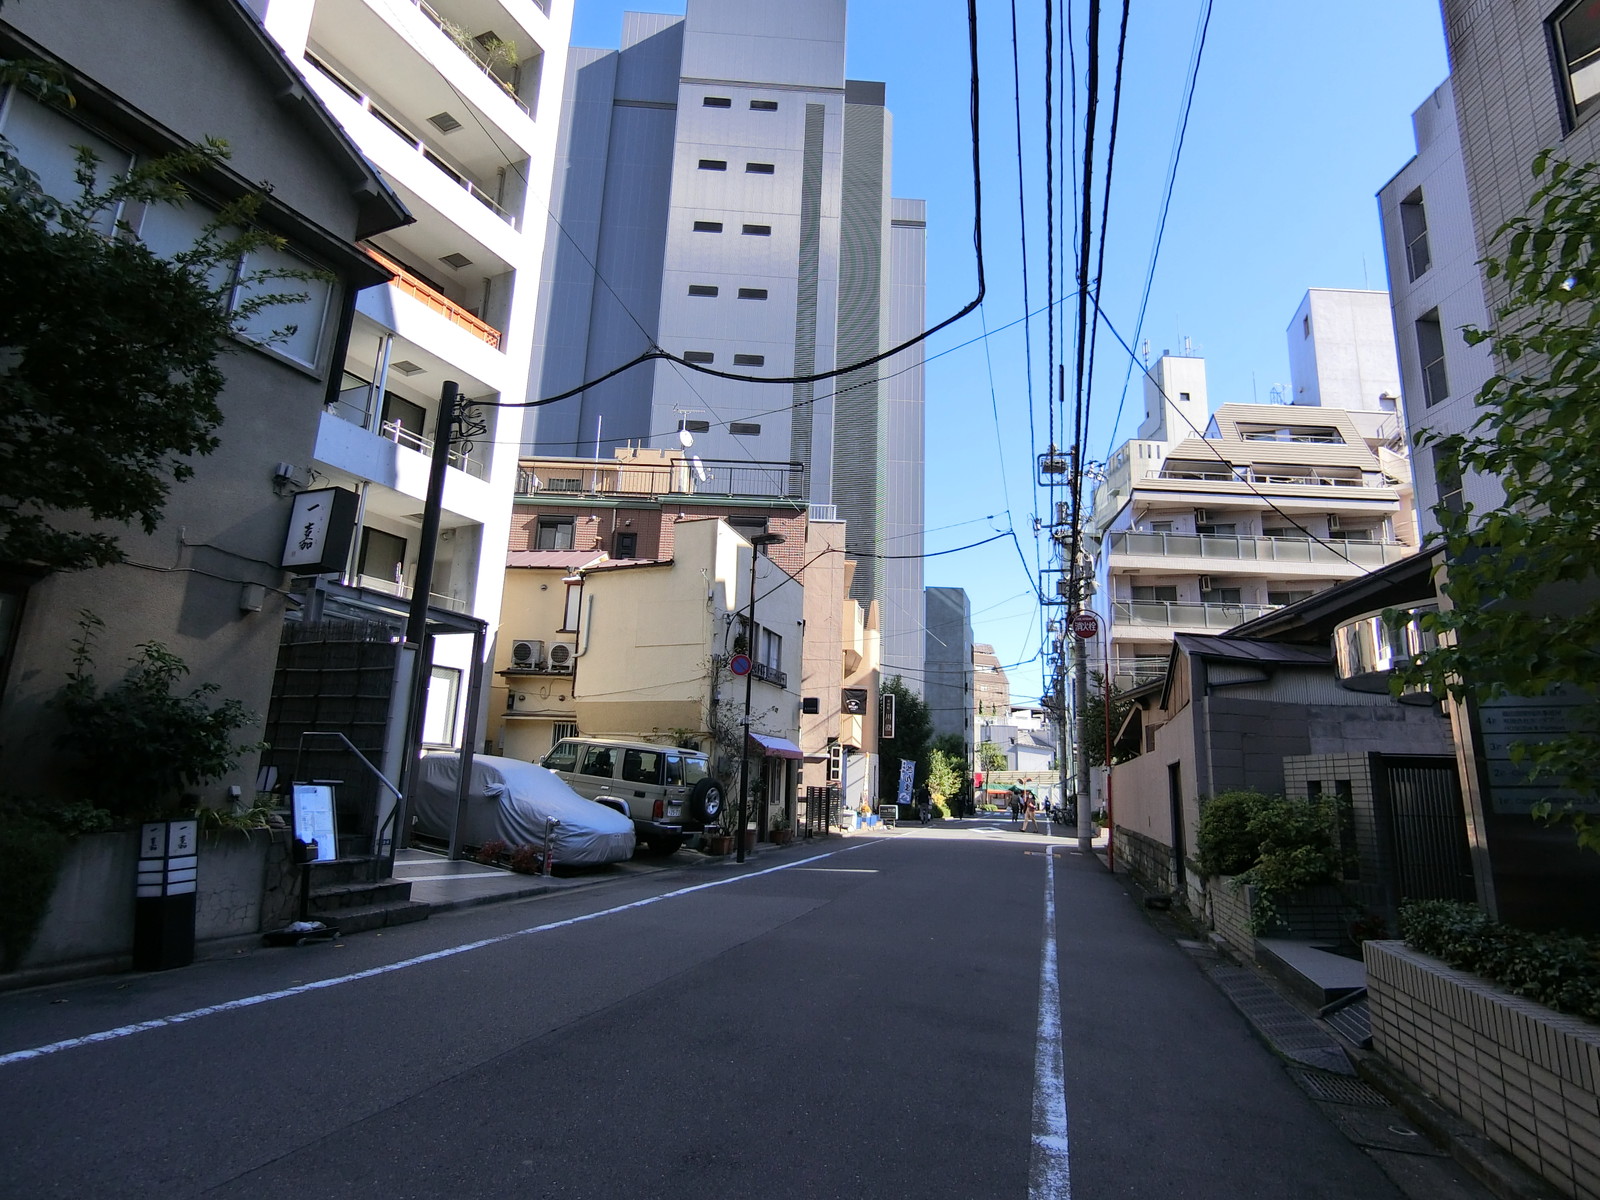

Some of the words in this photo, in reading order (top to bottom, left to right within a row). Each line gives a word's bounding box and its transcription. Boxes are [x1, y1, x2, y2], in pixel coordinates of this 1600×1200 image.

[299, 504, 320, 551] 一嘉
[1074, 621, 1097, 632] 消火栓
